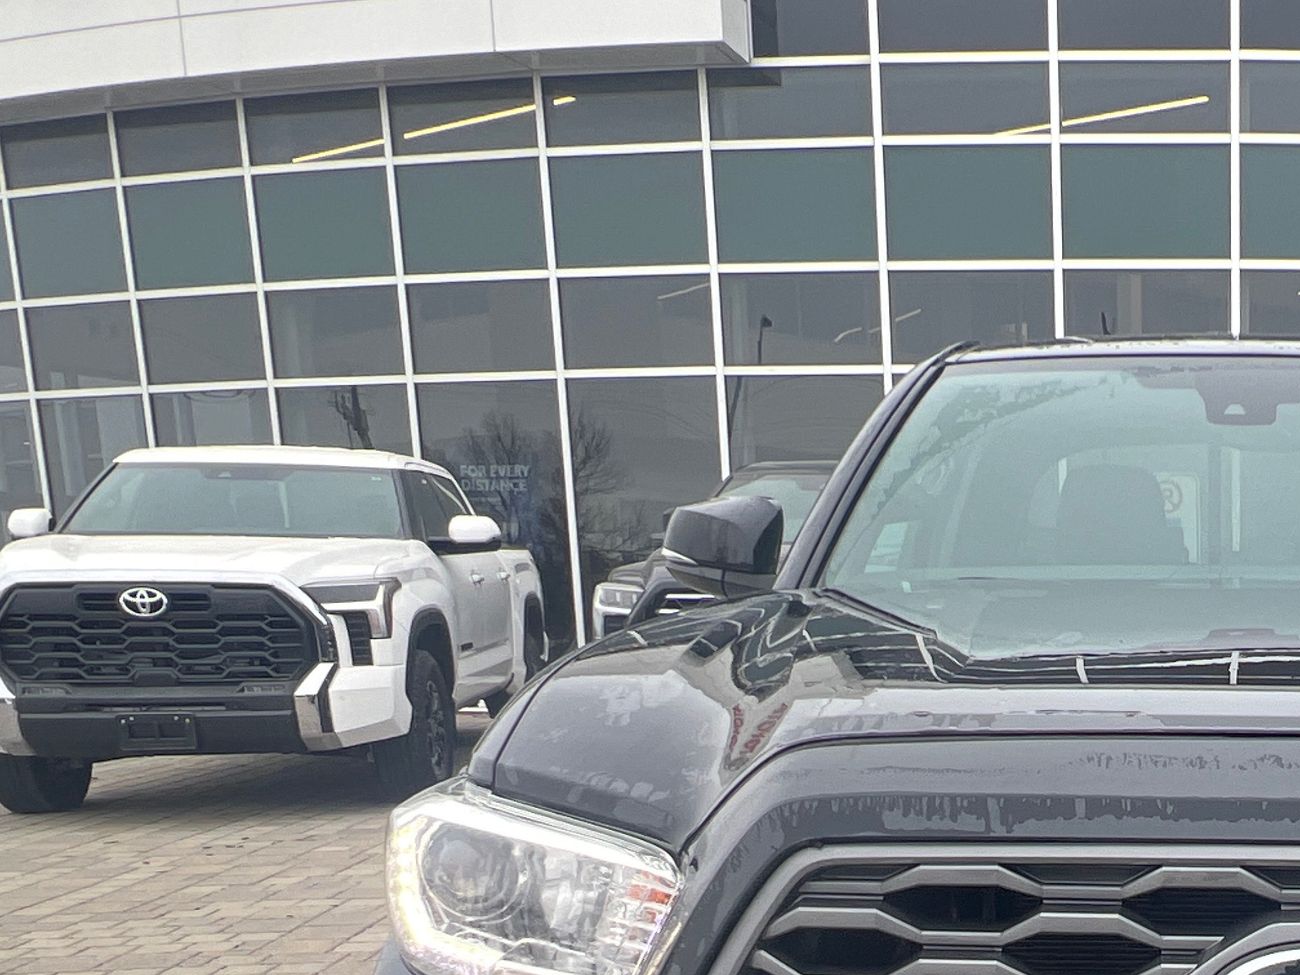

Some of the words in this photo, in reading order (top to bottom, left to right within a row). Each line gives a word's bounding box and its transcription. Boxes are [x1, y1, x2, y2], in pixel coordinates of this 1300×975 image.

[460, 464, 486, 478] FOR
[489, 464, 529, 478] EVERY
[461, 478, 529, 492] DISTANCE
